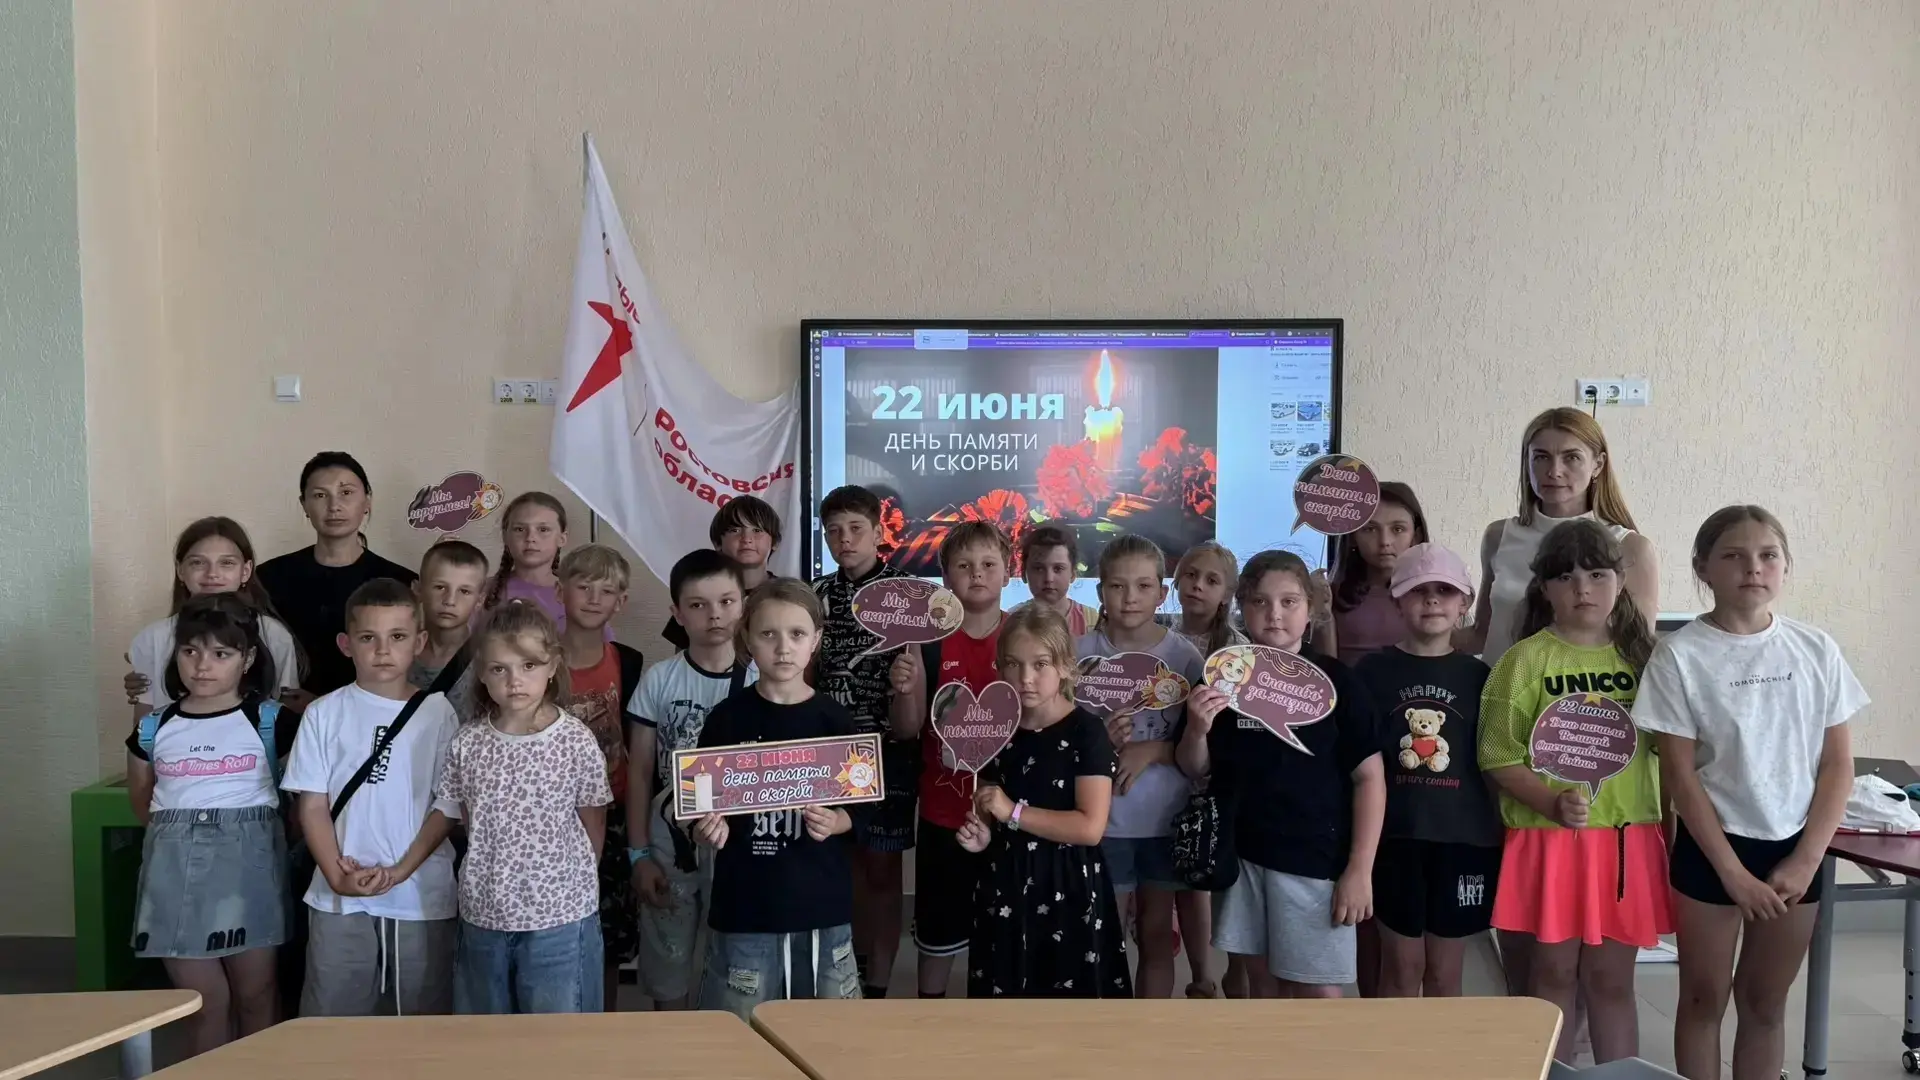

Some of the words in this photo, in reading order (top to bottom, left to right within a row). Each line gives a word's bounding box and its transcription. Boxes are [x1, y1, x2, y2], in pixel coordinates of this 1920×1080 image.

[872, 385, 923, 420] 22
[938, 392, 1065, 420] июня
[885, 433, 941, 453] ДЕНЬ
[949, 433, 1038, 450] ПАМЯТИ
[911, 454, 925, 471] И
[933, 454, 1018, 471] СКОРБИ
[1320, 463, 1360, 483] День
[428, 490, 453, 504] Мы
[1295, 482, 1364, 503] памяти
[1364, 493, 1377, 505] и
[410, 495, 472, 522] гордимся!
[1304, 501, 1361, 521] скорби
[881, 592, 910, 609] Мы
[860, 608, 929, 629] скорбим!
[1099, 661, 1125, 673] Они
[1074, 675, 1135, 687] ражались
[1257, 671, 1322, 701] Спасибо
[1543, 671, 1634, 696] UNICO
[1084, 685, 1135, 703] Родину!
[1245, 685, 1267, 701] за
[1267, 692, 1324, 716] жизнь!
[1399, 685, 1457, 704] HAPPY
[963, 704, 993, 721] Мы
[1557, 700, 1578, 713] 22
[1578, 705, 1620, 721] июня
[943, 719, 1013, 738] помним!
[1550, 717, 1579, 729] День
[1579, 721, 1626, 739] начала
[1559, 729, 1610, 747] Великой
[203, 744, 216, 752] the
[1535, 740, 1630, 764] Отечественной
[187, 760, 220, 772] Times
[224, 757, 249, 769] Roll
[736, 753, 758, 769] 22
[761, 748, 817, 767] ИЮНЯ
[723, 767, 760, 787] день
[763, 765, 831, 783] памяти
[743, 791, 754, 803] и
[758, 780, 813, 805] скорби
[1457, 874, 1484, 907] ART
